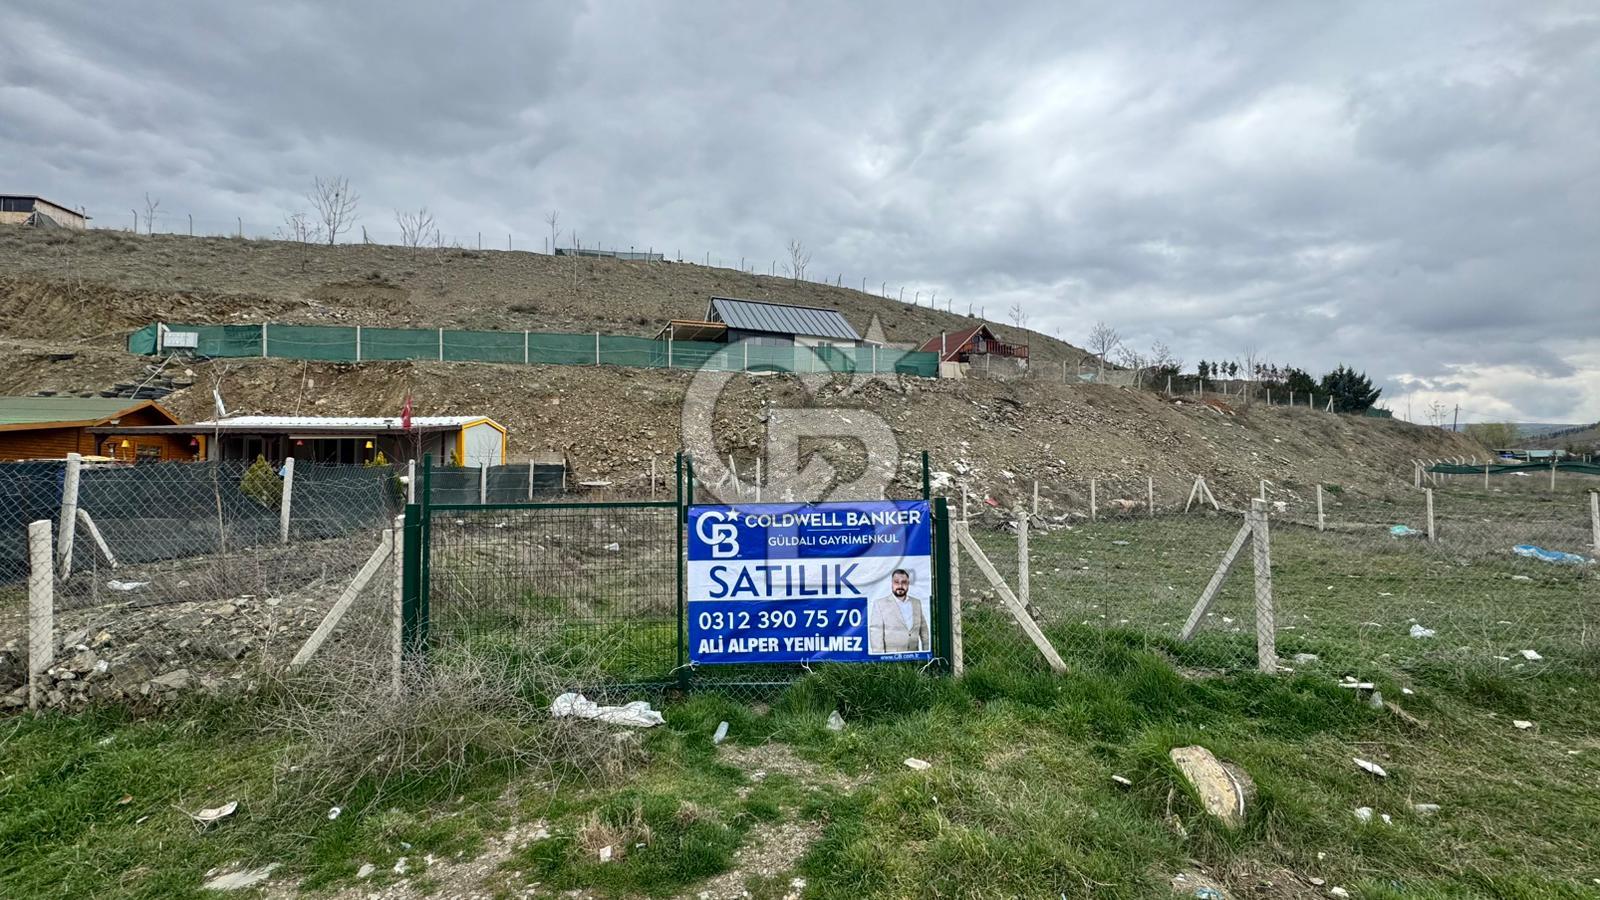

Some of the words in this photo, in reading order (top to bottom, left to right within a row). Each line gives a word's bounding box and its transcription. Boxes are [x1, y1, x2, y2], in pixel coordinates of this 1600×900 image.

[745, 512, 842, 528] COLDWELL
[846, 510, 921, 526] BANKER
[696, 510, 740, 558] CB
[768, 534, 816, 546] GÜLDALI
[819, 533, 899, 545] GAYRİMENKUL
[709, 563, 861, 598] SATILIK
[699, 611, 750, 630] 0312
[758, 610, 797, 629] 390
[804, 609, 829, 628] 75
[836, 608, 862, 627] 70
[698, 635, 723, 653] ALİ
[728, 637, 779, 653] ALPER
[784, 633, 863, 652] YENİLMEZ
